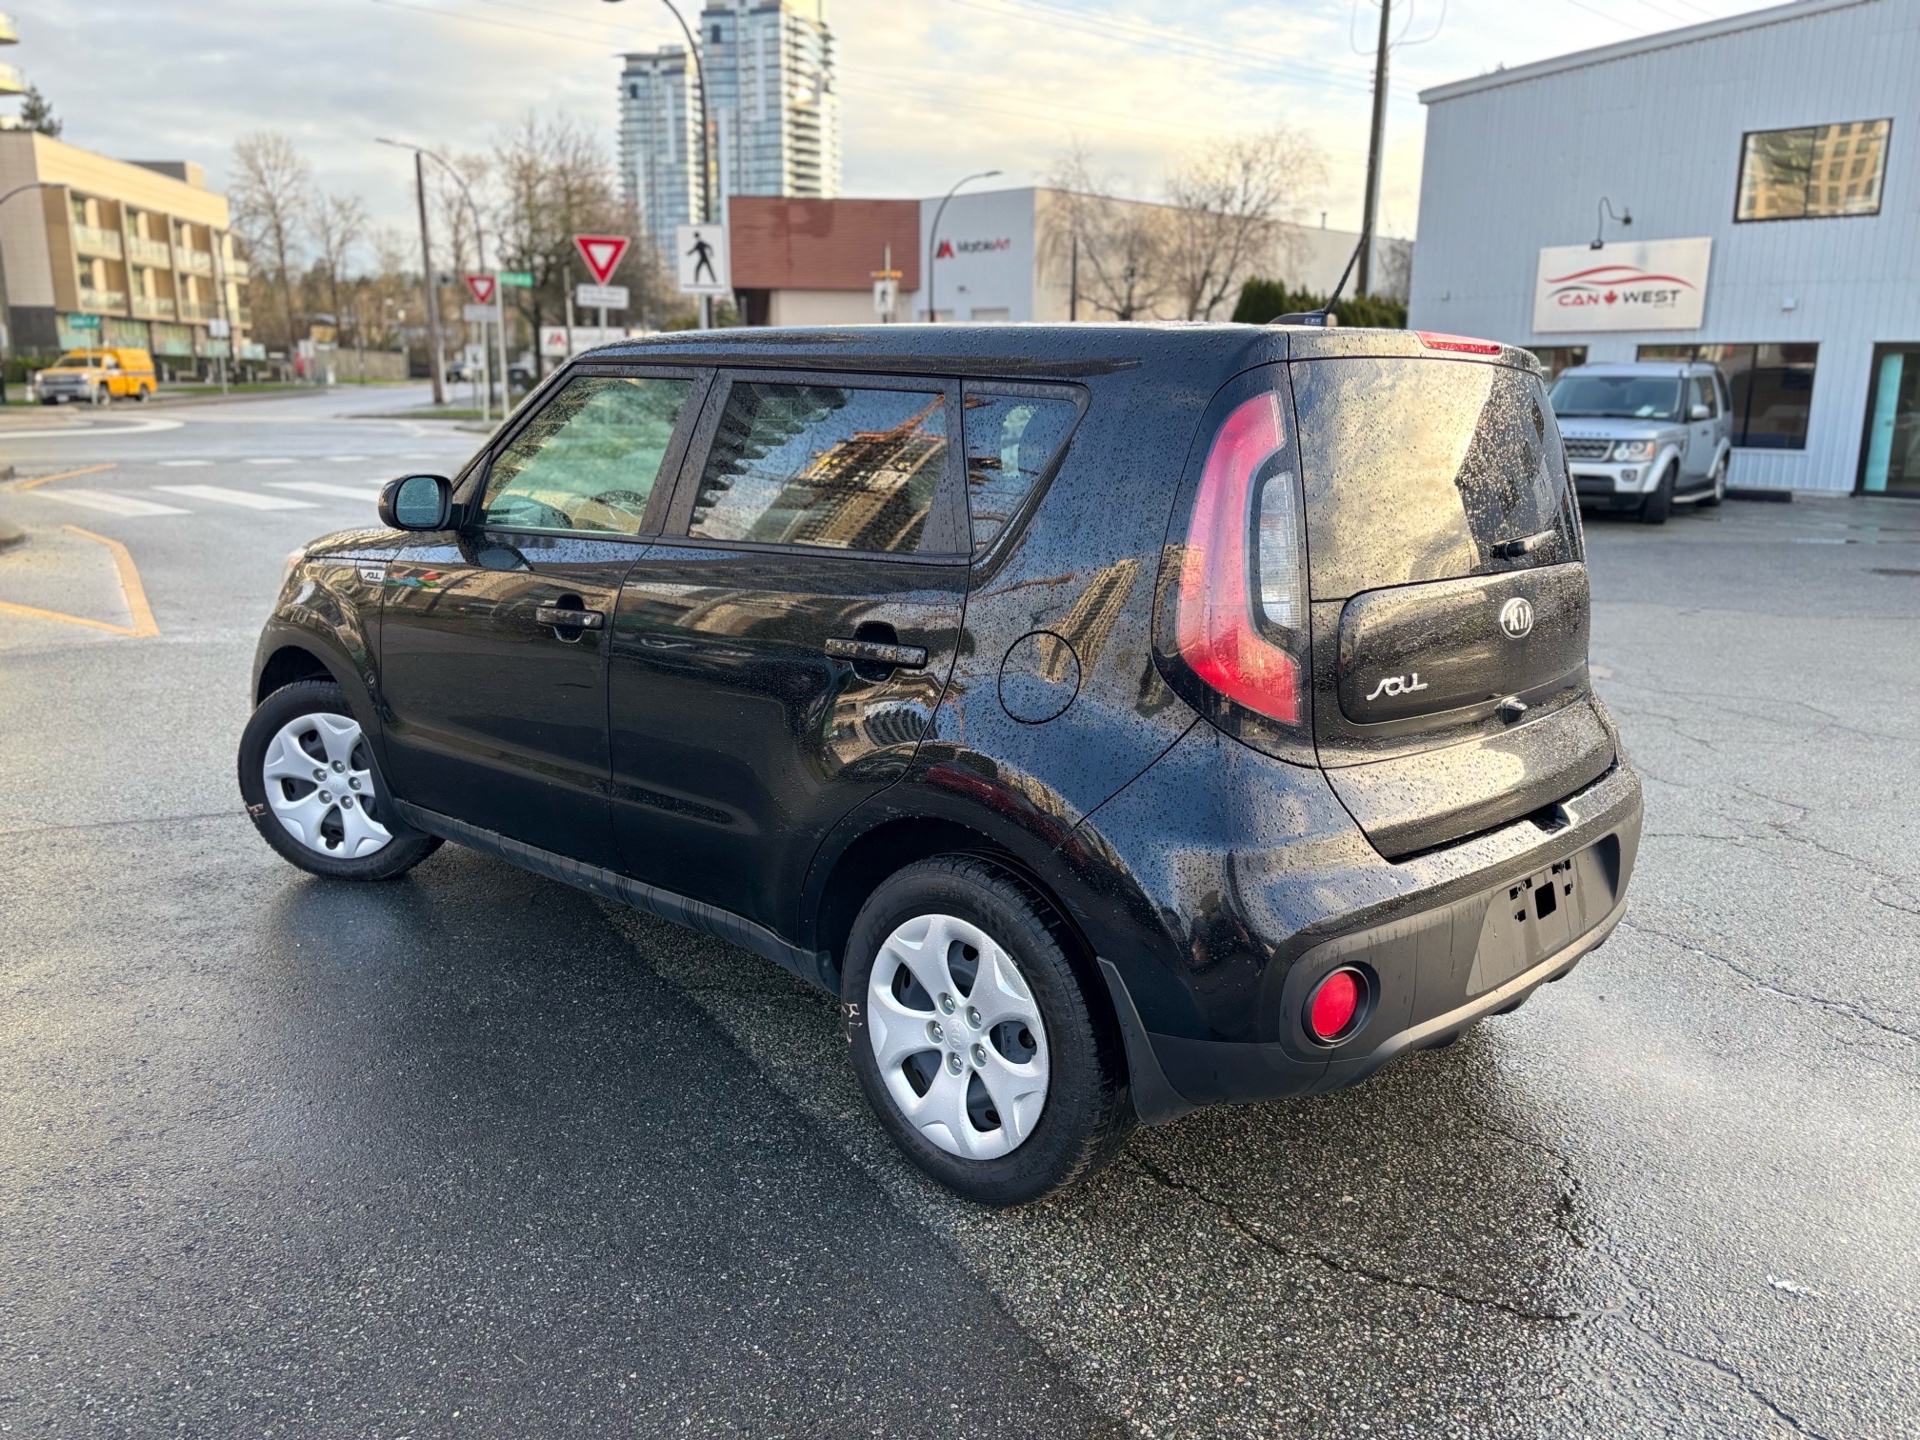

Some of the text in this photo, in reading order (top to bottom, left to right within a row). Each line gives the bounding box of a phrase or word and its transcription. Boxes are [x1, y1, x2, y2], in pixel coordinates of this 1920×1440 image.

[1558, 290, 1681, 306] CAN WEST
[1508, 606, 1533, 631] KIA
[1366, 672, 1429, 701] SOUL
